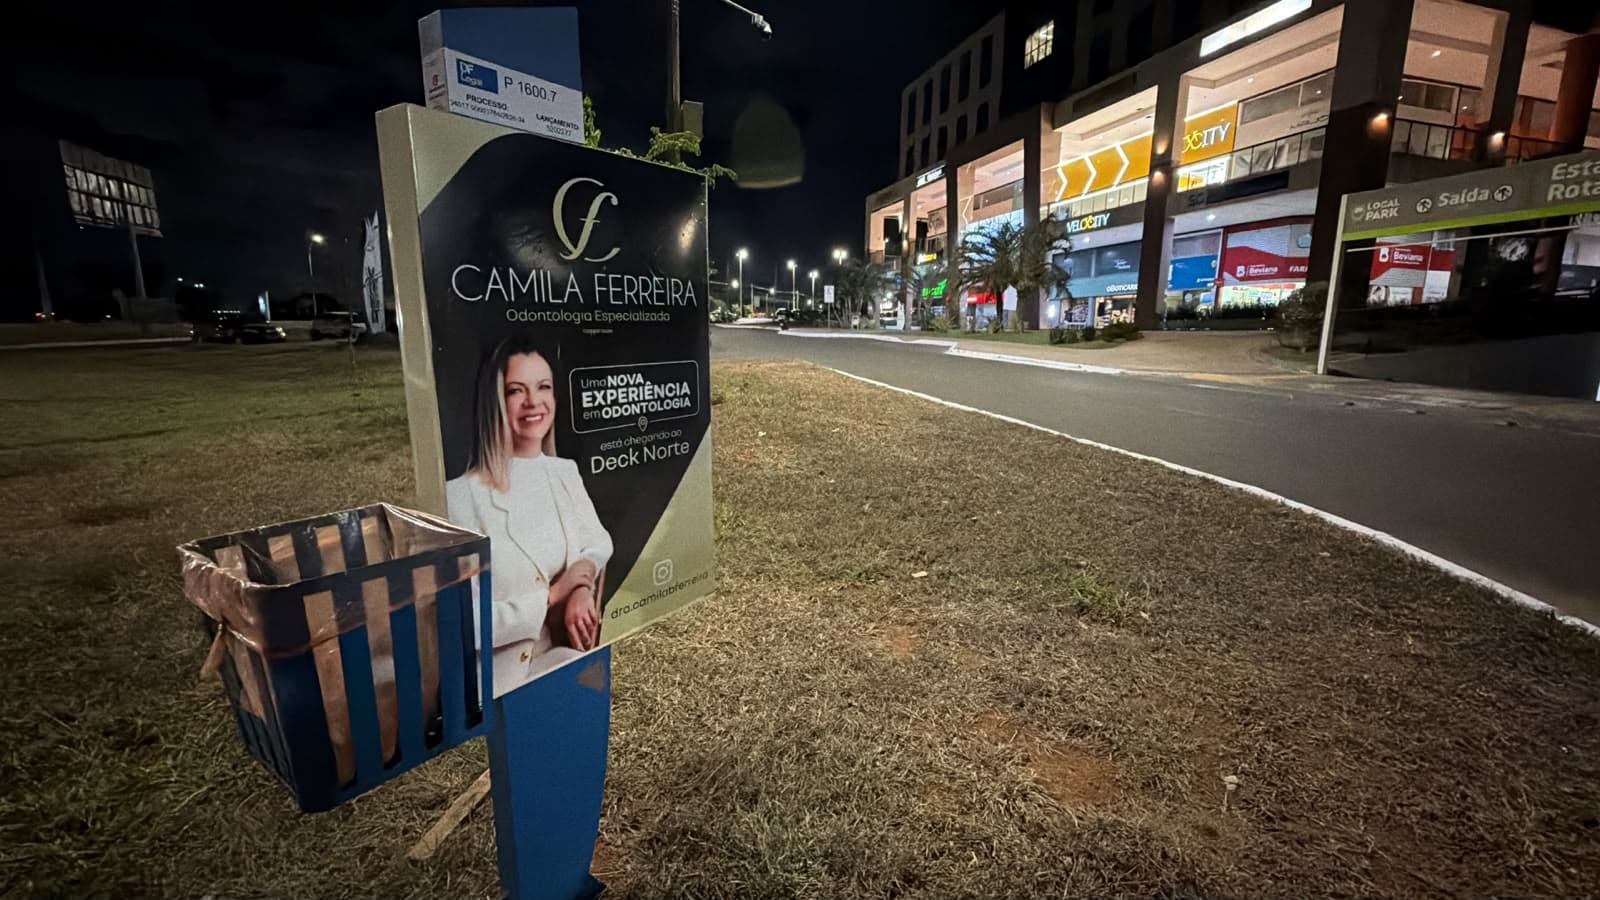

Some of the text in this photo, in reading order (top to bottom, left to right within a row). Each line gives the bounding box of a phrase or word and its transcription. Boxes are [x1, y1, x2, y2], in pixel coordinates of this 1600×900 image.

[504, 76, 557, 102] P 1600.7
[1367, 199, 1400, 210] LOCAL
[1438, 187, 1490, 207] Saída
[1366, 207, 1399, 220] PARK
[451, 264, 698, 307] CAMILA FERREIRA
[506, 308, 670, 324] Odontologia Especializada
[580, 373, 644, 389] Uma NOVA
[582, 380, 691, 408] EXPERIÊNCIA
[583, 397, 691, 420] em ODONTOLOGIA
[624, 431, 670, 448] chegando
[671, 429, 682, 437] ao
[591, 441, 690, 474] Deck Norte
